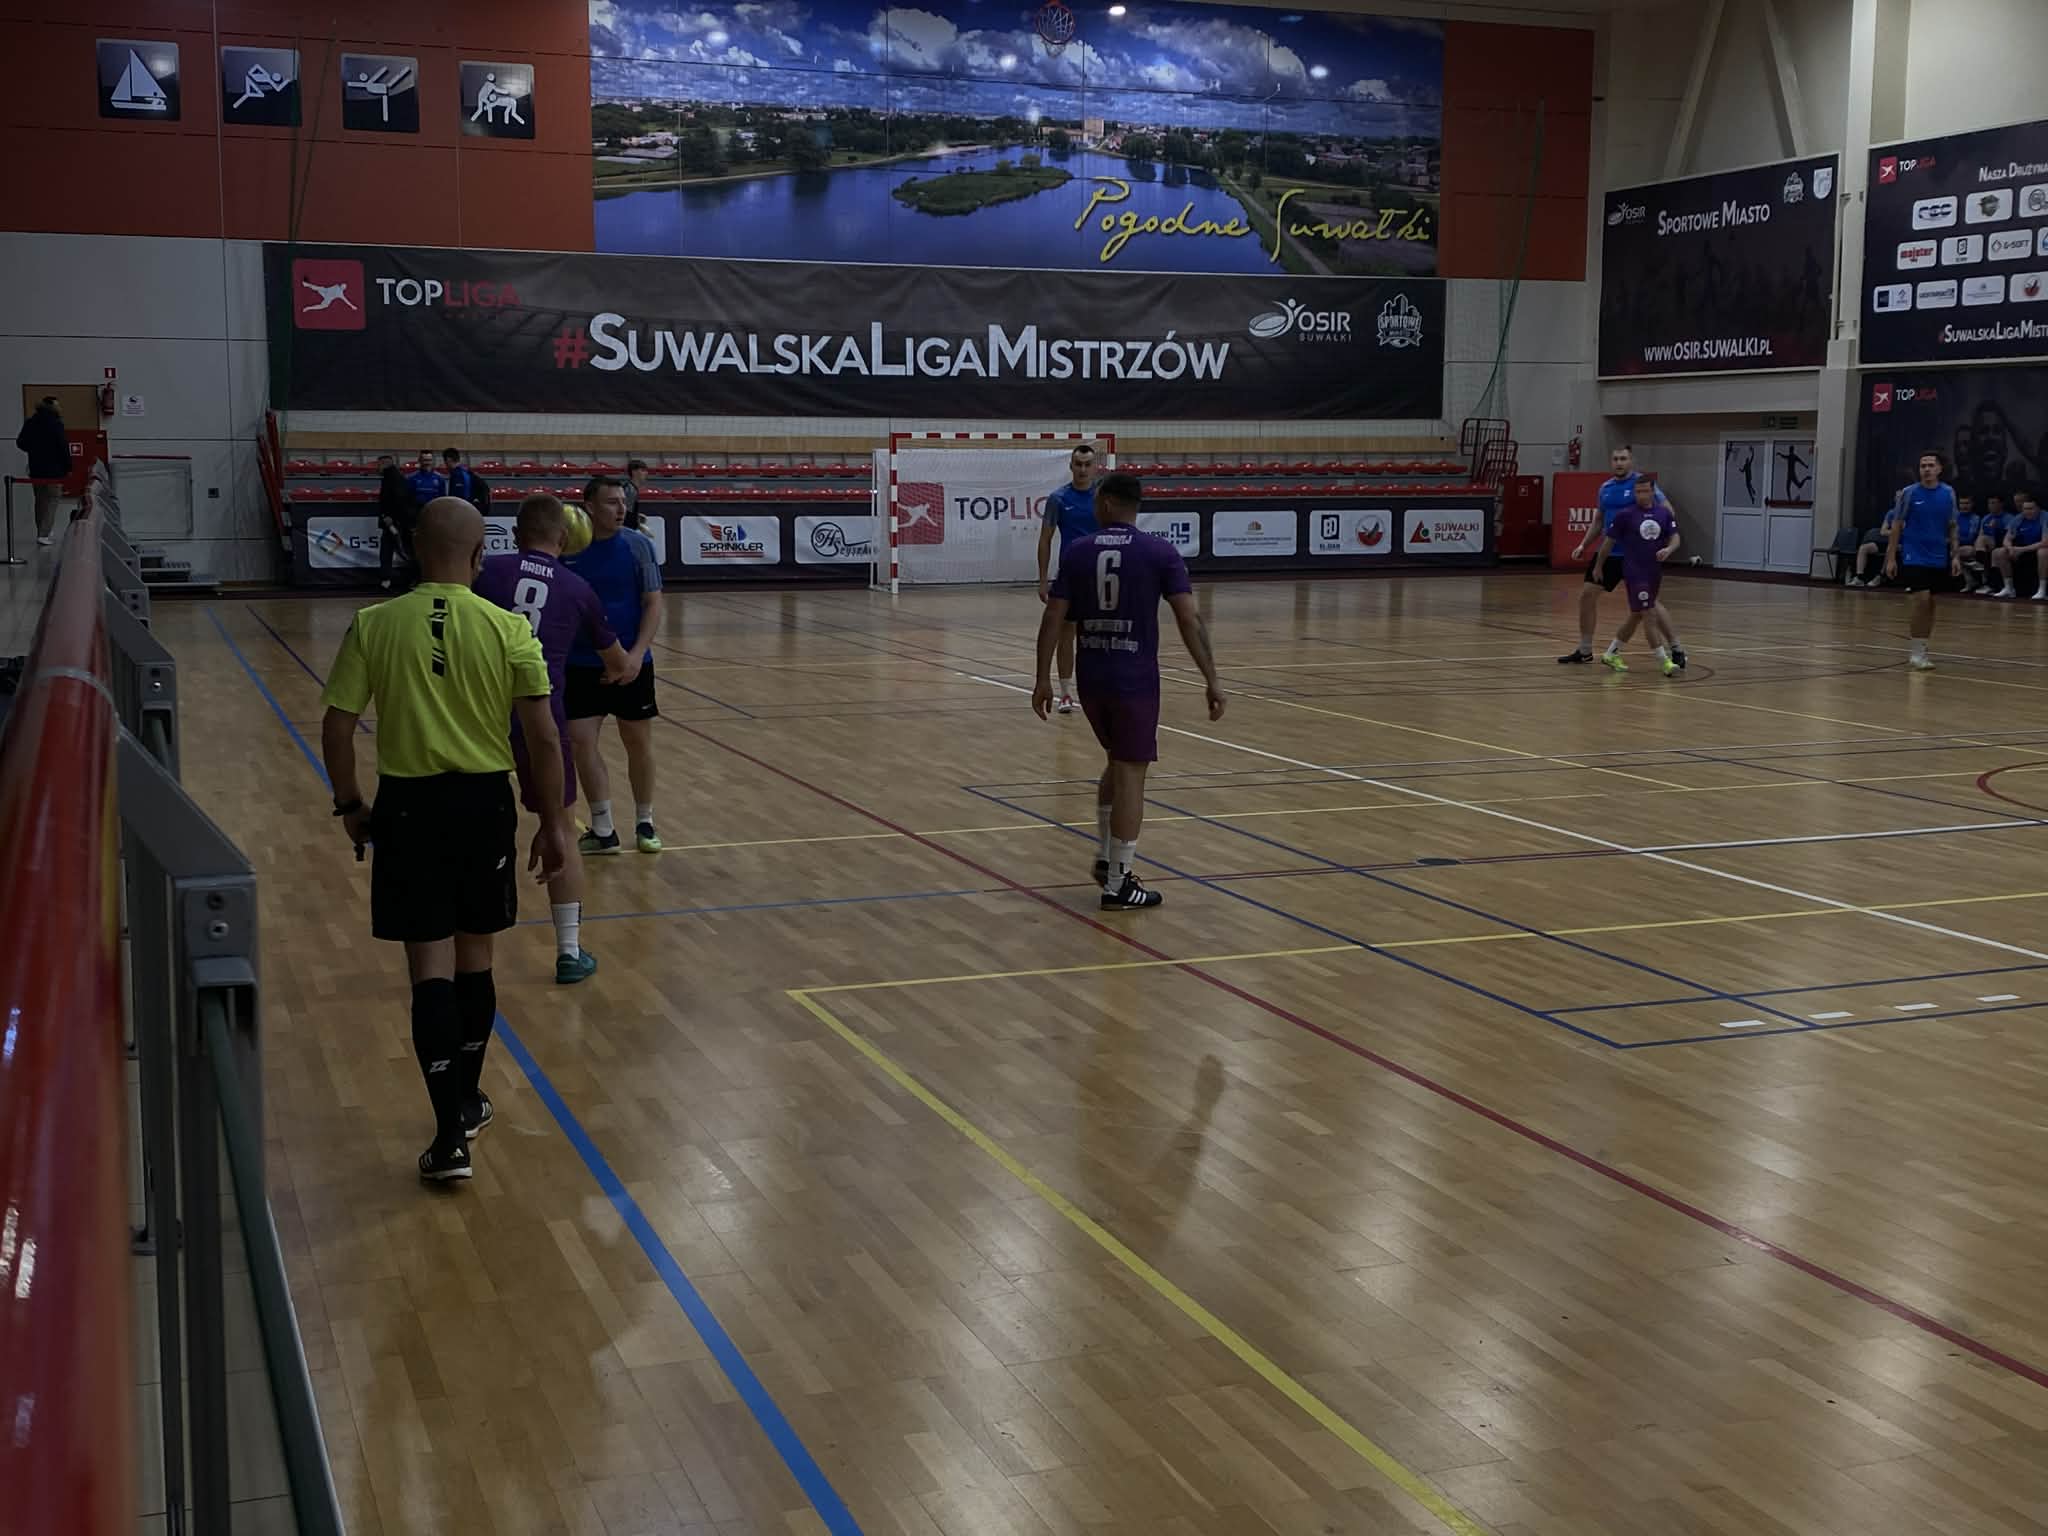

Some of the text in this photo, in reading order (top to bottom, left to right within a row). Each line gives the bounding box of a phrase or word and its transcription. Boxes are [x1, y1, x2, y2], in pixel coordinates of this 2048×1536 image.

[1074, 176, 1251, 264] Pogodne
[1656, 199, 1771, 237] SPORTOWE MIASTO
[375, 277, 522, 307] TOPLIGA
[1298, 311, 1351, 332] OSIR
[700, 542, 764, 552] SPRINKLER
[1434, 532, 1467, 542] PLAZA
[520, 559, 555, 579] RADEK
[1096, 549, 1122, 611] 6
[511, 577, 549, 637] 8
